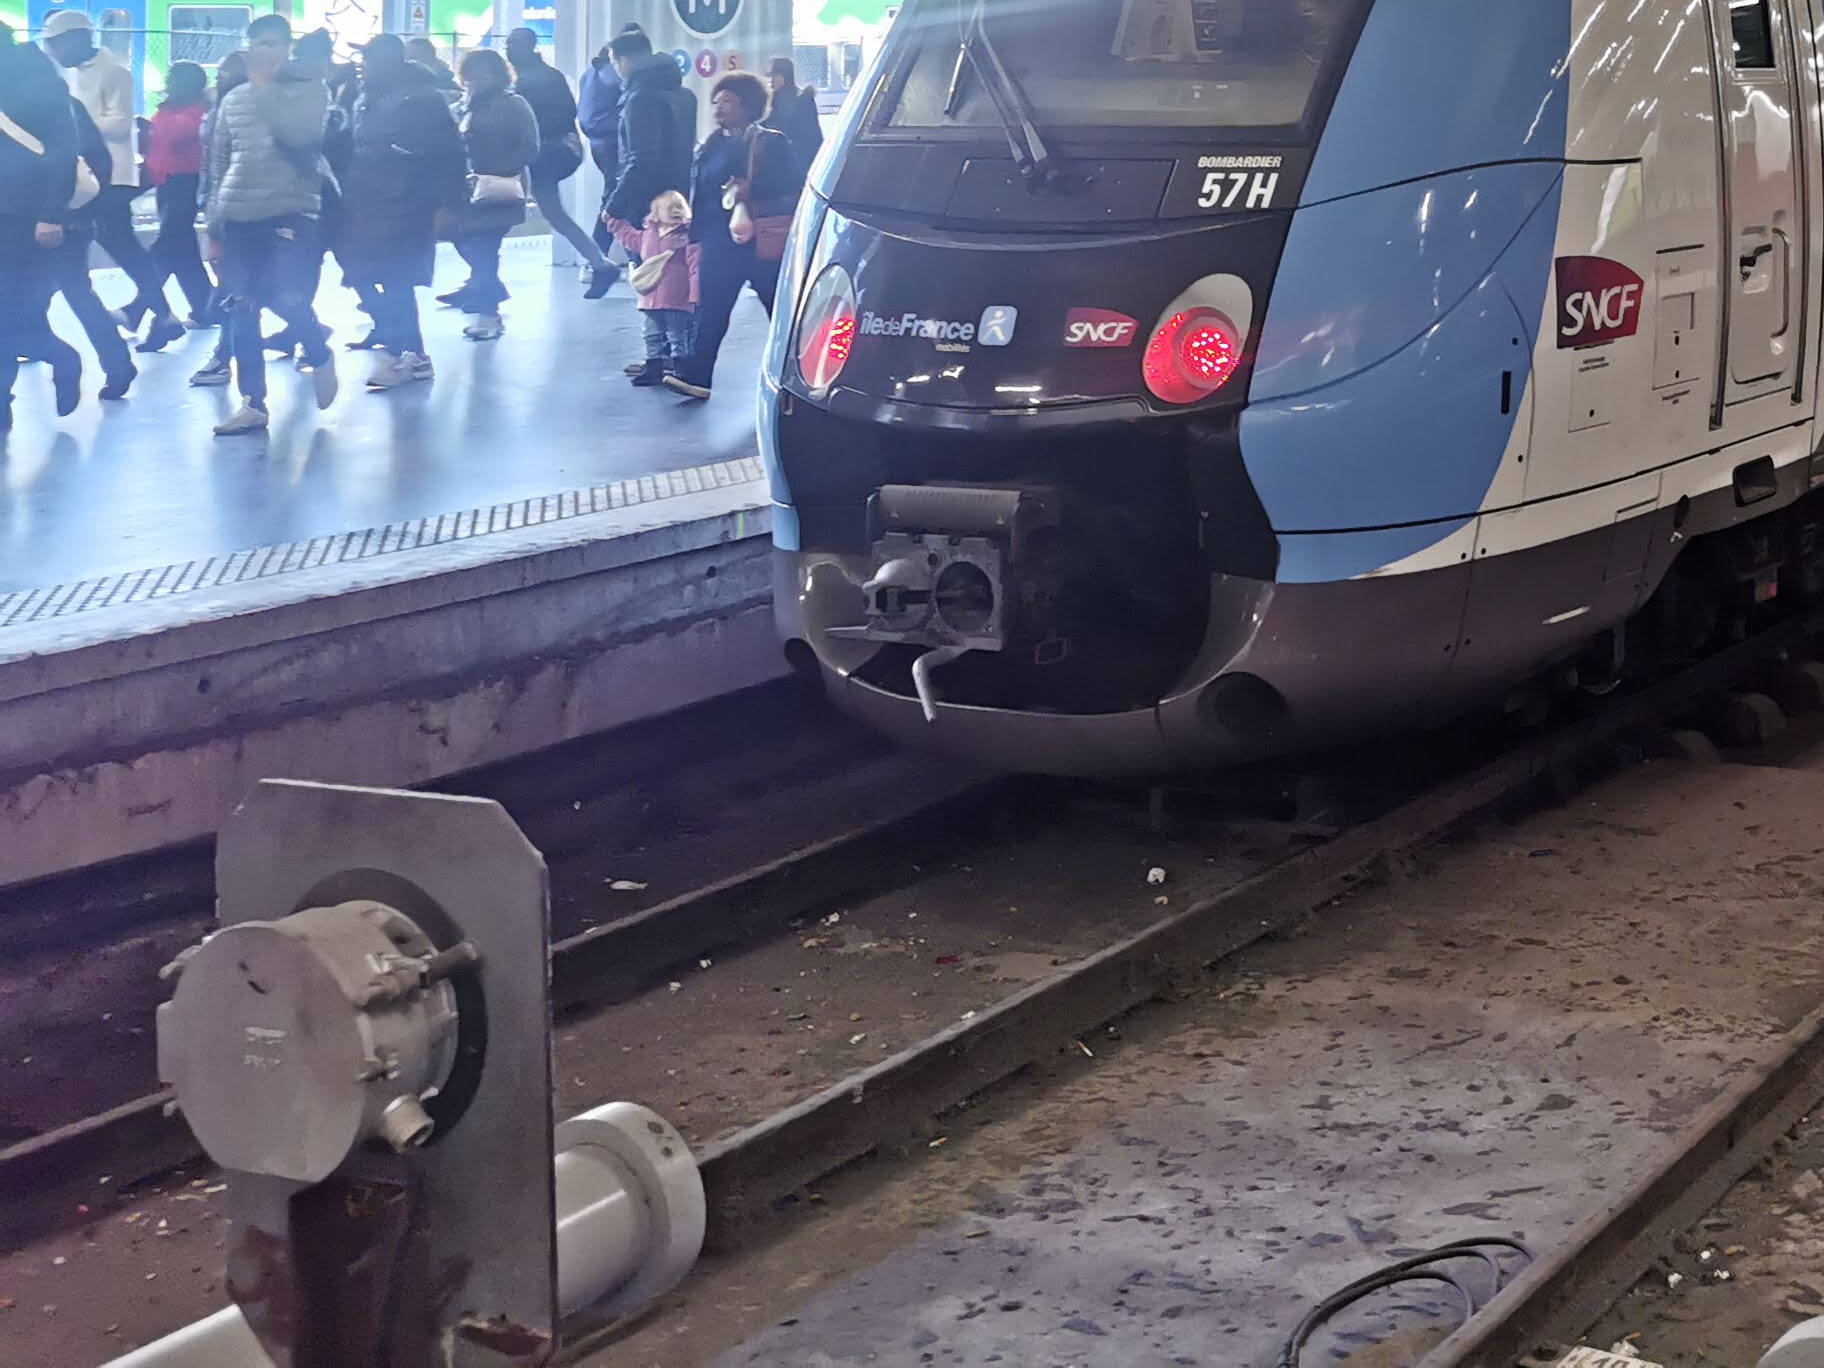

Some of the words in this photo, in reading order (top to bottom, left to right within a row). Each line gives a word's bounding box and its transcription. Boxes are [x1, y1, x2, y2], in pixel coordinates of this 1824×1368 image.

[700, 54, 712, 72] 4
[1197, 155, 1282, 168] BOMBARDIER
[1561, 283, 1640, 336] SNCF
[1064, 321, 1134, 343] SNCF
